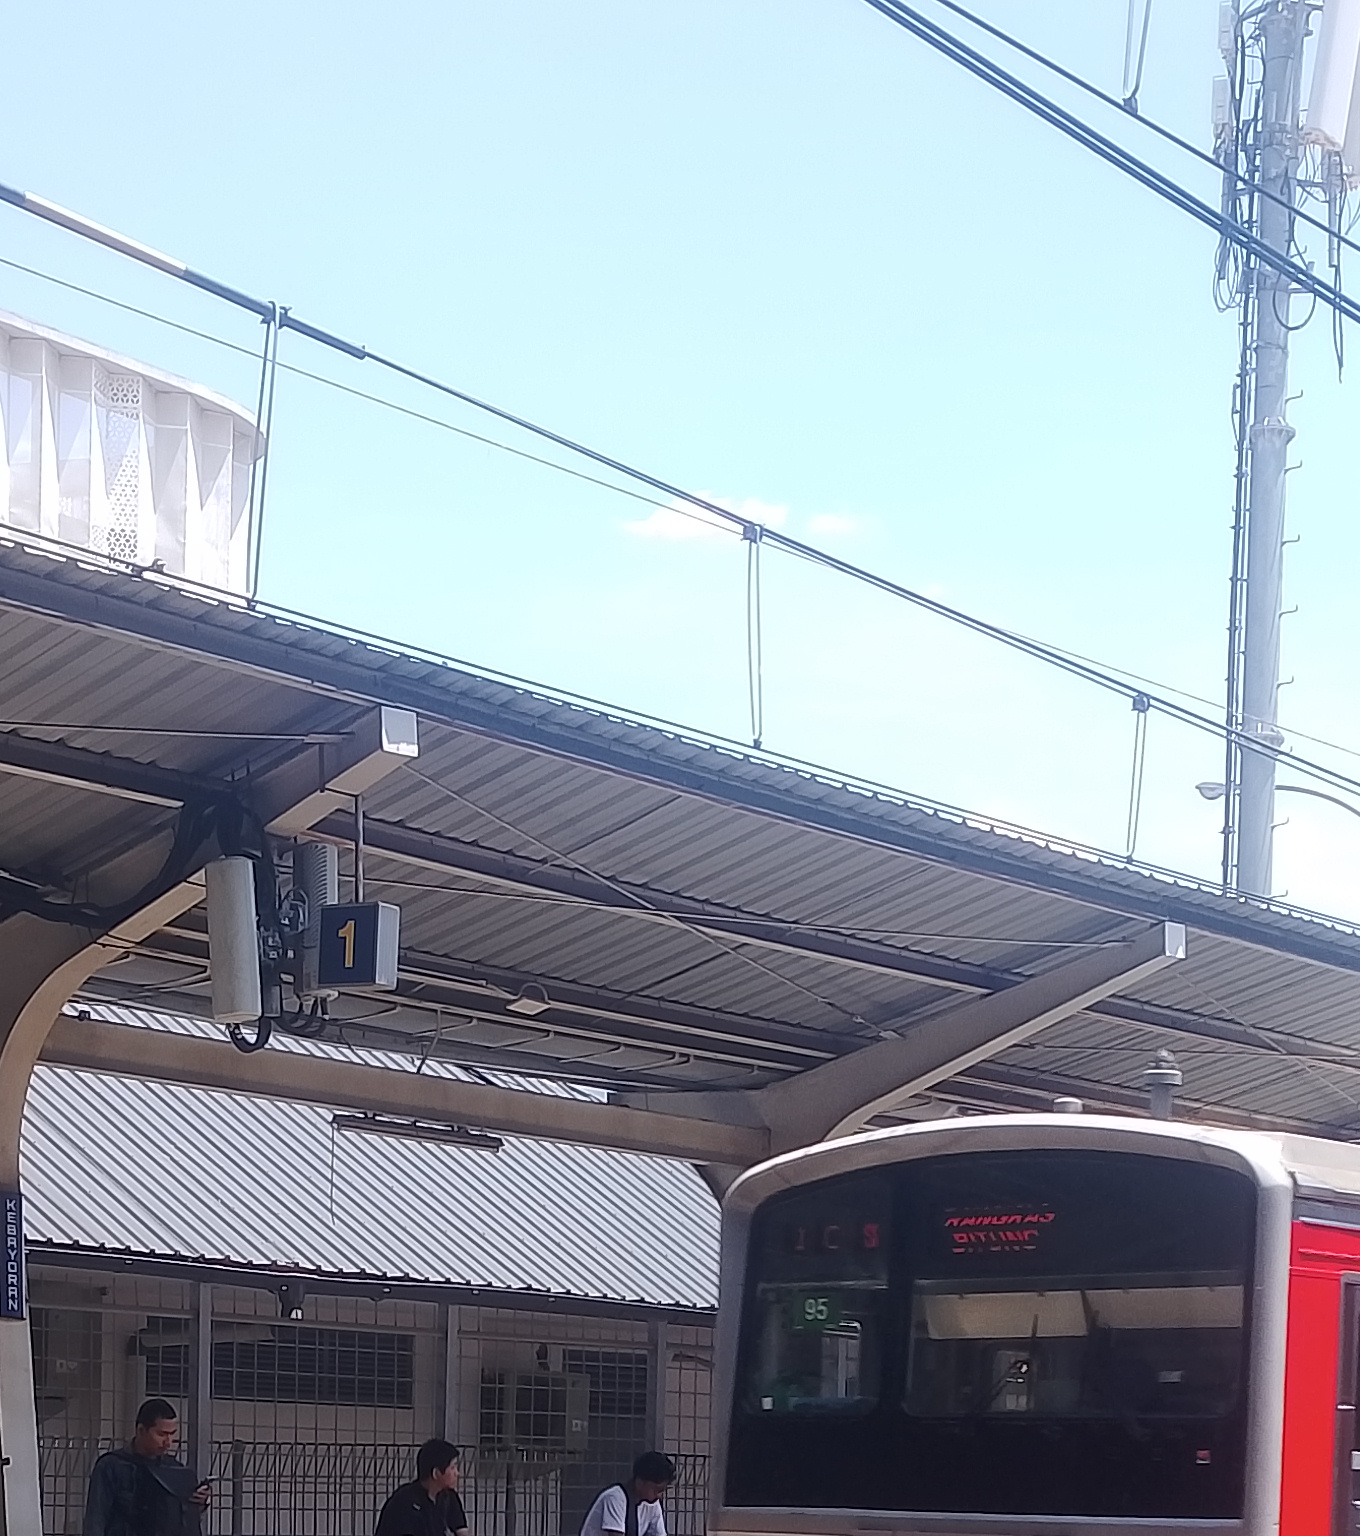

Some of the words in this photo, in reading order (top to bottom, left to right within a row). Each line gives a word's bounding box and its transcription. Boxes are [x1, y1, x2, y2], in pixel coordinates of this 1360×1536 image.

[338, 920, 355, 968] 1
[6, 1199, 19, 1311] KEBAYORAN
[804, 1298, 829, 1320] 95
